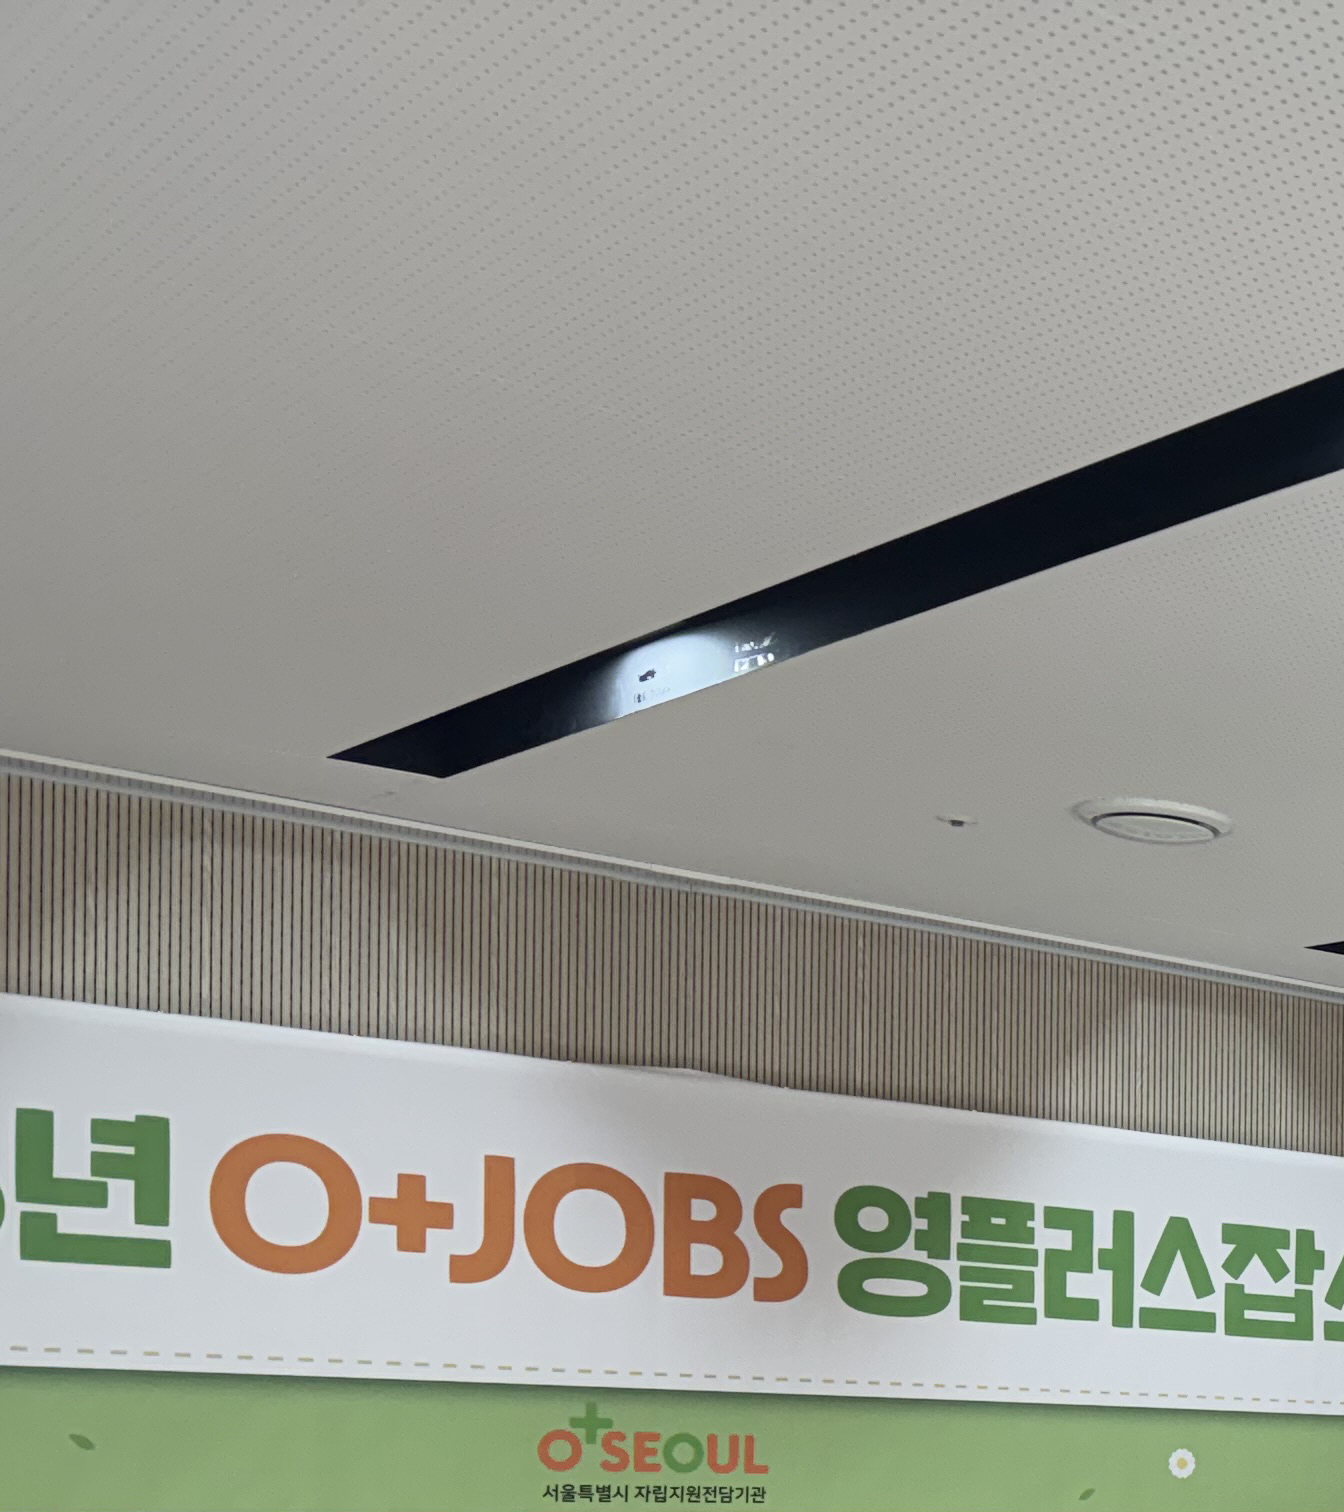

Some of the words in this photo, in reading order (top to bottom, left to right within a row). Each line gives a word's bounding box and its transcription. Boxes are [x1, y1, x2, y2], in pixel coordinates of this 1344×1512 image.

[0, 1107, 172, 1269] 년
[209, 1132, 810, 1303] O+JOBS
[542, 1484, 630, 1503] 서울특별시
[634, 1485, 767, 1504] 자립지원전담기관
